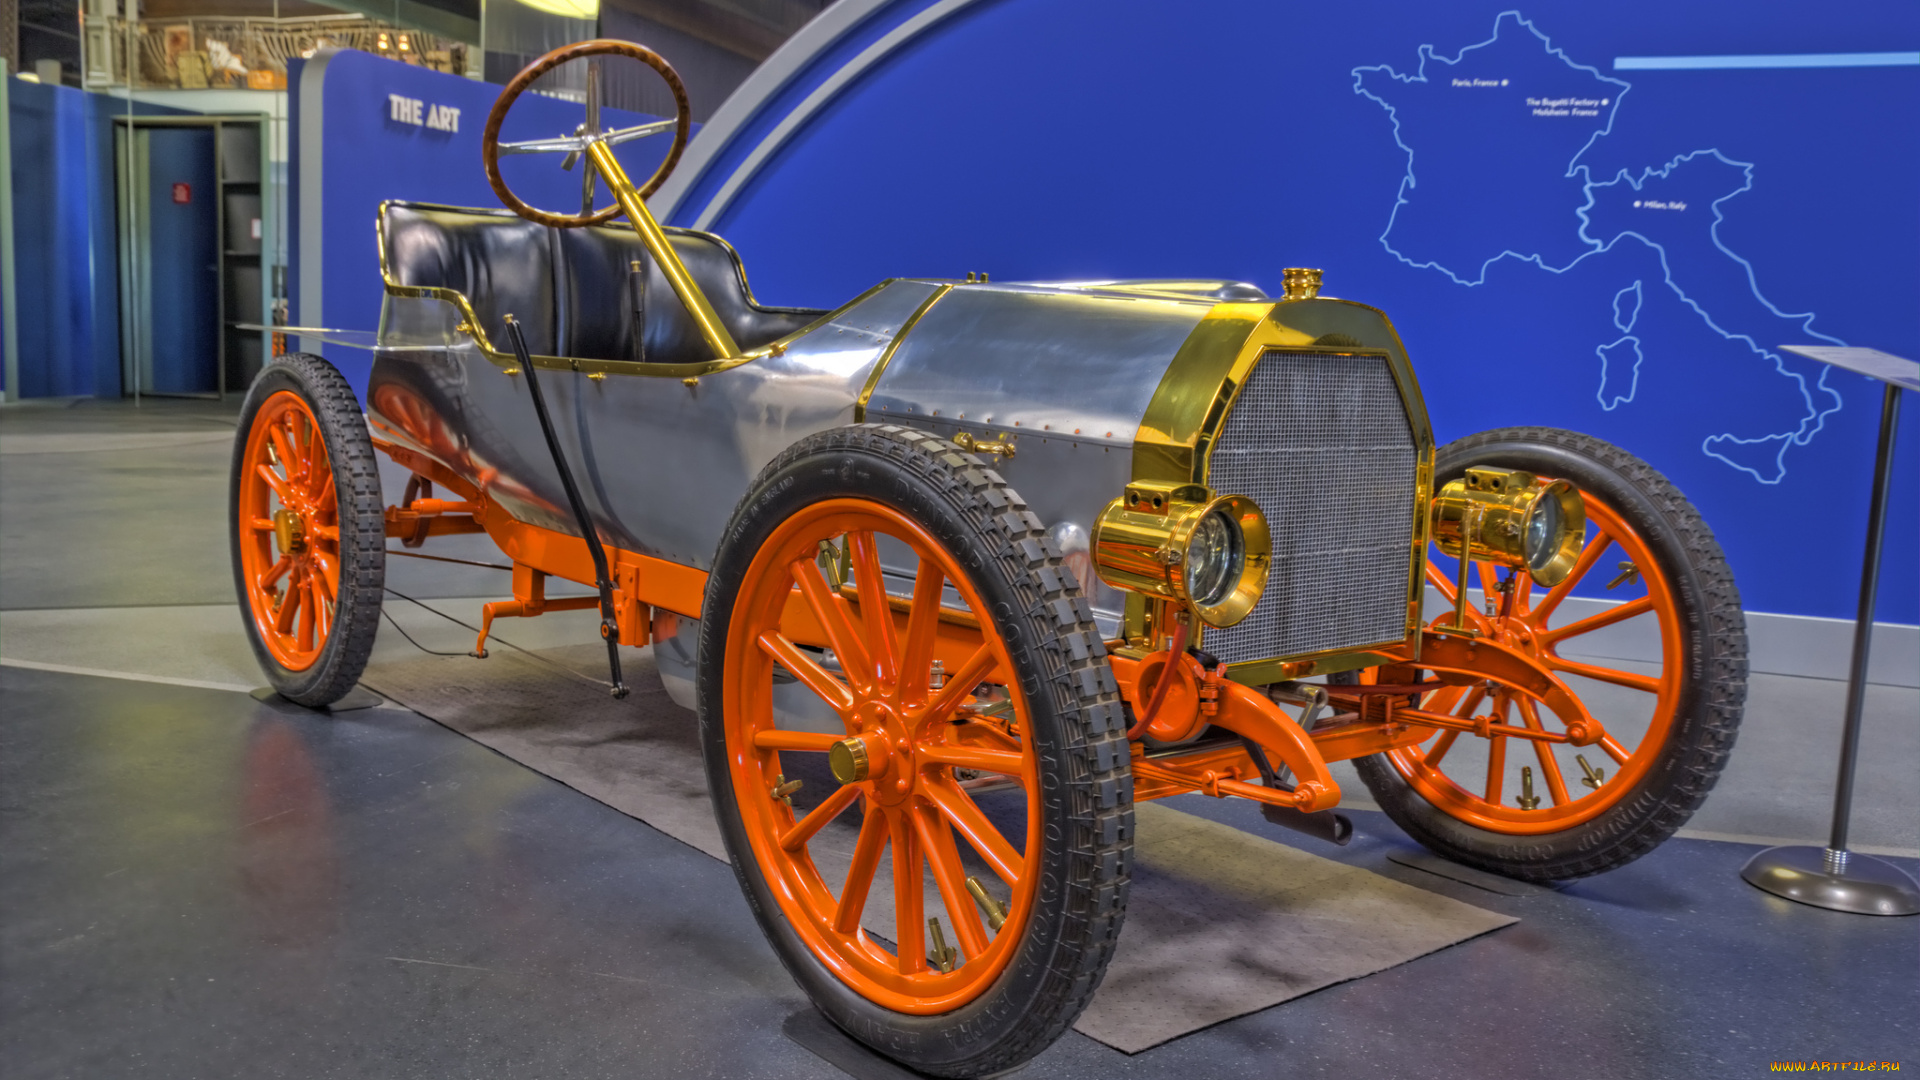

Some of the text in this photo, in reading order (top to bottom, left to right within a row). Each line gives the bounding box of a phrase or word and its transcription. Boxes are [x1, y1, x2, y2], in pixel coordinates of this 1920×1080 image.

[1473, 78, 1499, 88] France
[1526, 97, 1600, 108] The Bugatti Factory
[388, 94, 461, 133] THE ART
[1532, 108, 1598, 116] Molsheim France
[1668, 201, 1687, 212] Italy
[895, 477, 985, 569] DUNLOP
[994, 601, 1042, 697] CORD
